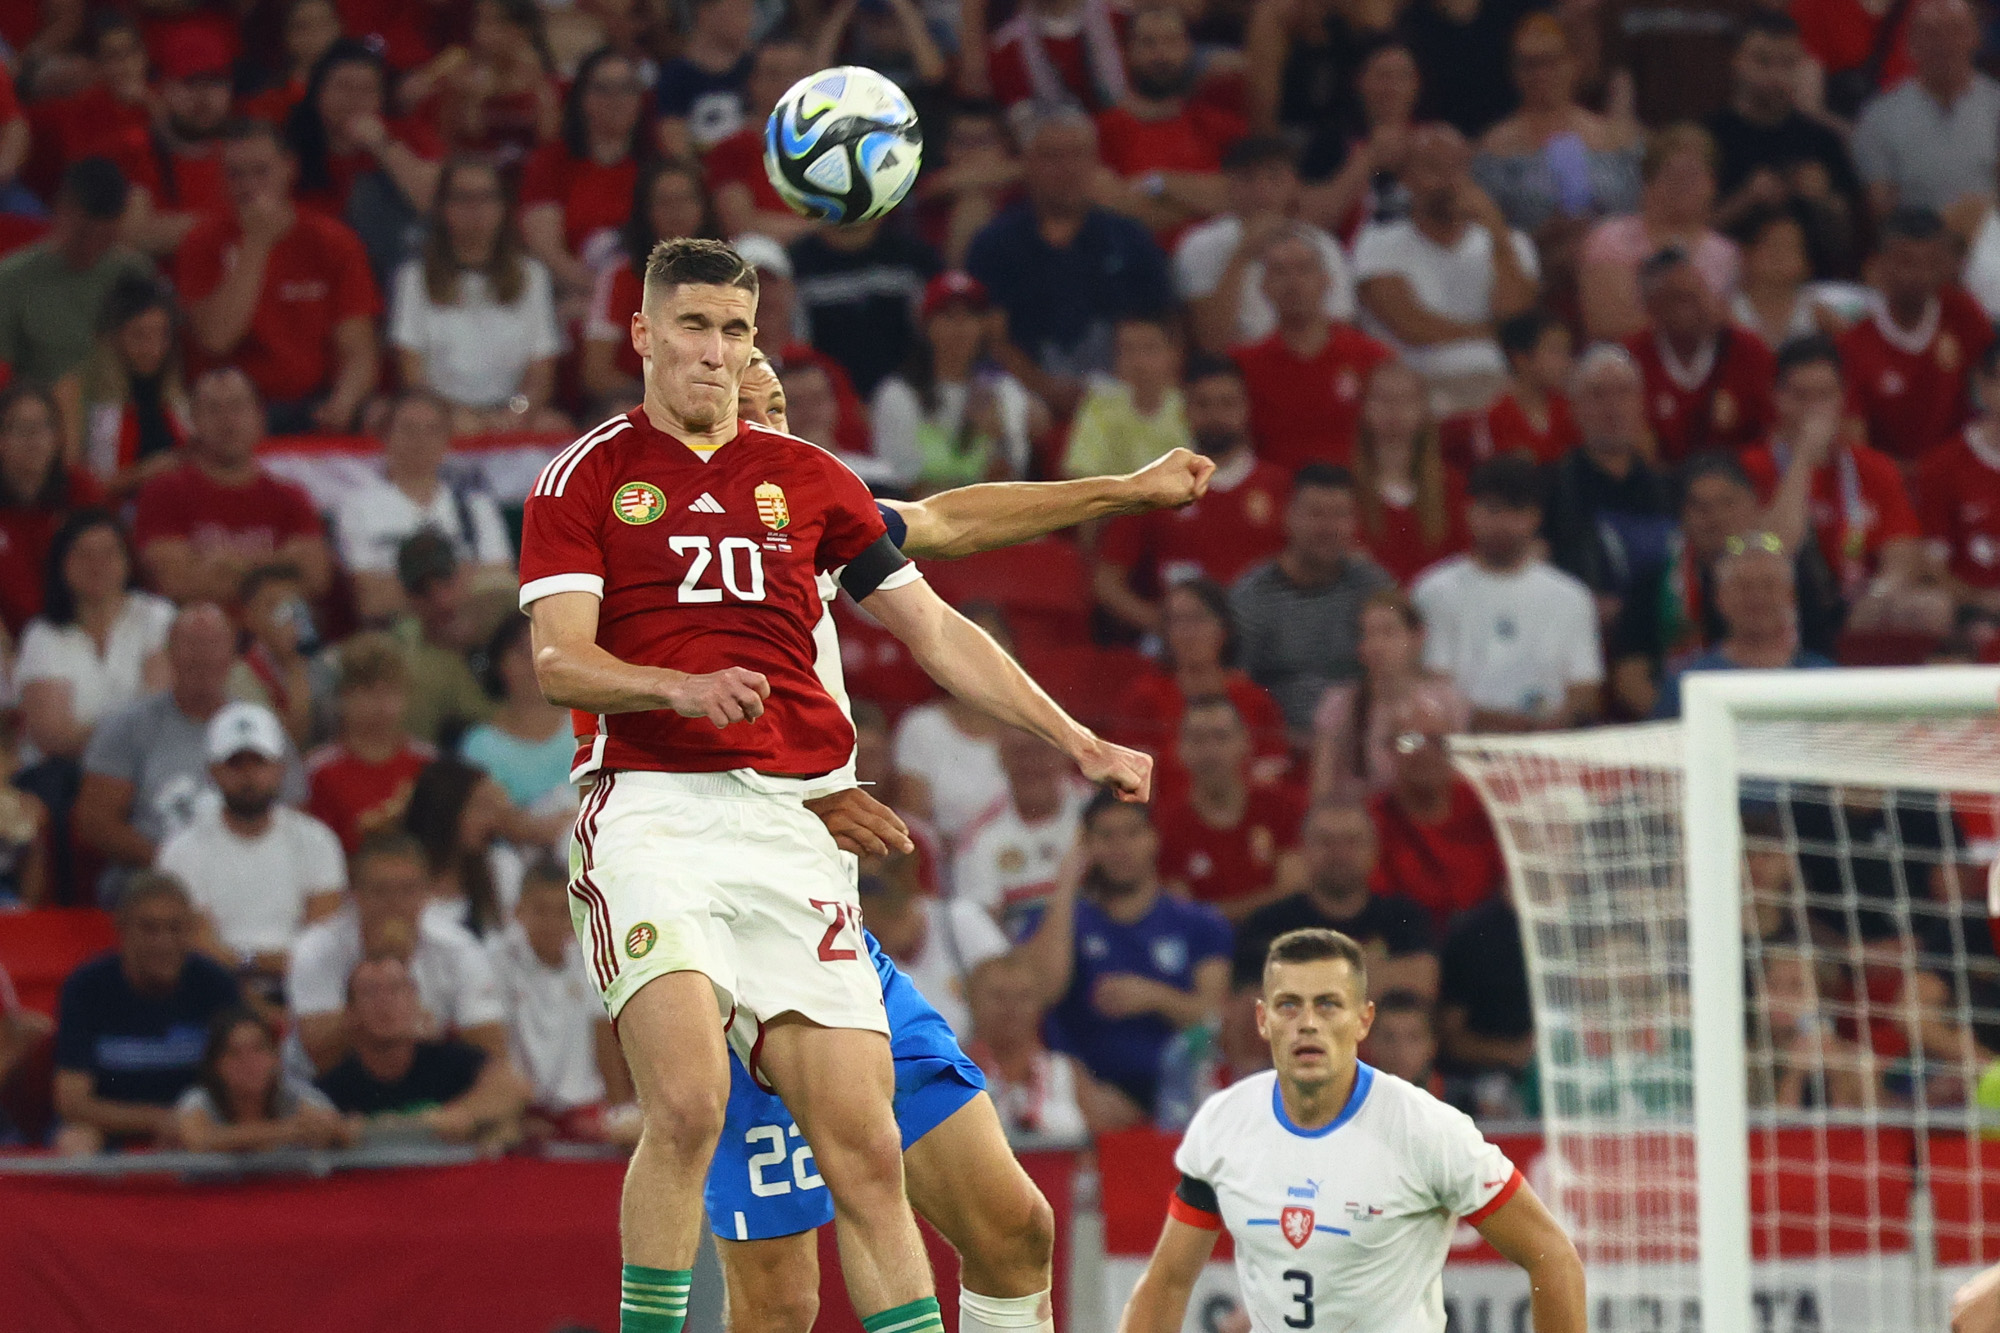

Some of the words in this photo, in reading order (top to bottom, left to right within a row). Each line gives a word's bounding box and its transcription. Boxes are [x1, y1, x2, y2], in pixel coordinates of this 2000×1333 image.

[668, 535, 766, 603] 20
[745, 1121, 826, 1198] 22
[1283, 1269, 1315, 1329] 3
